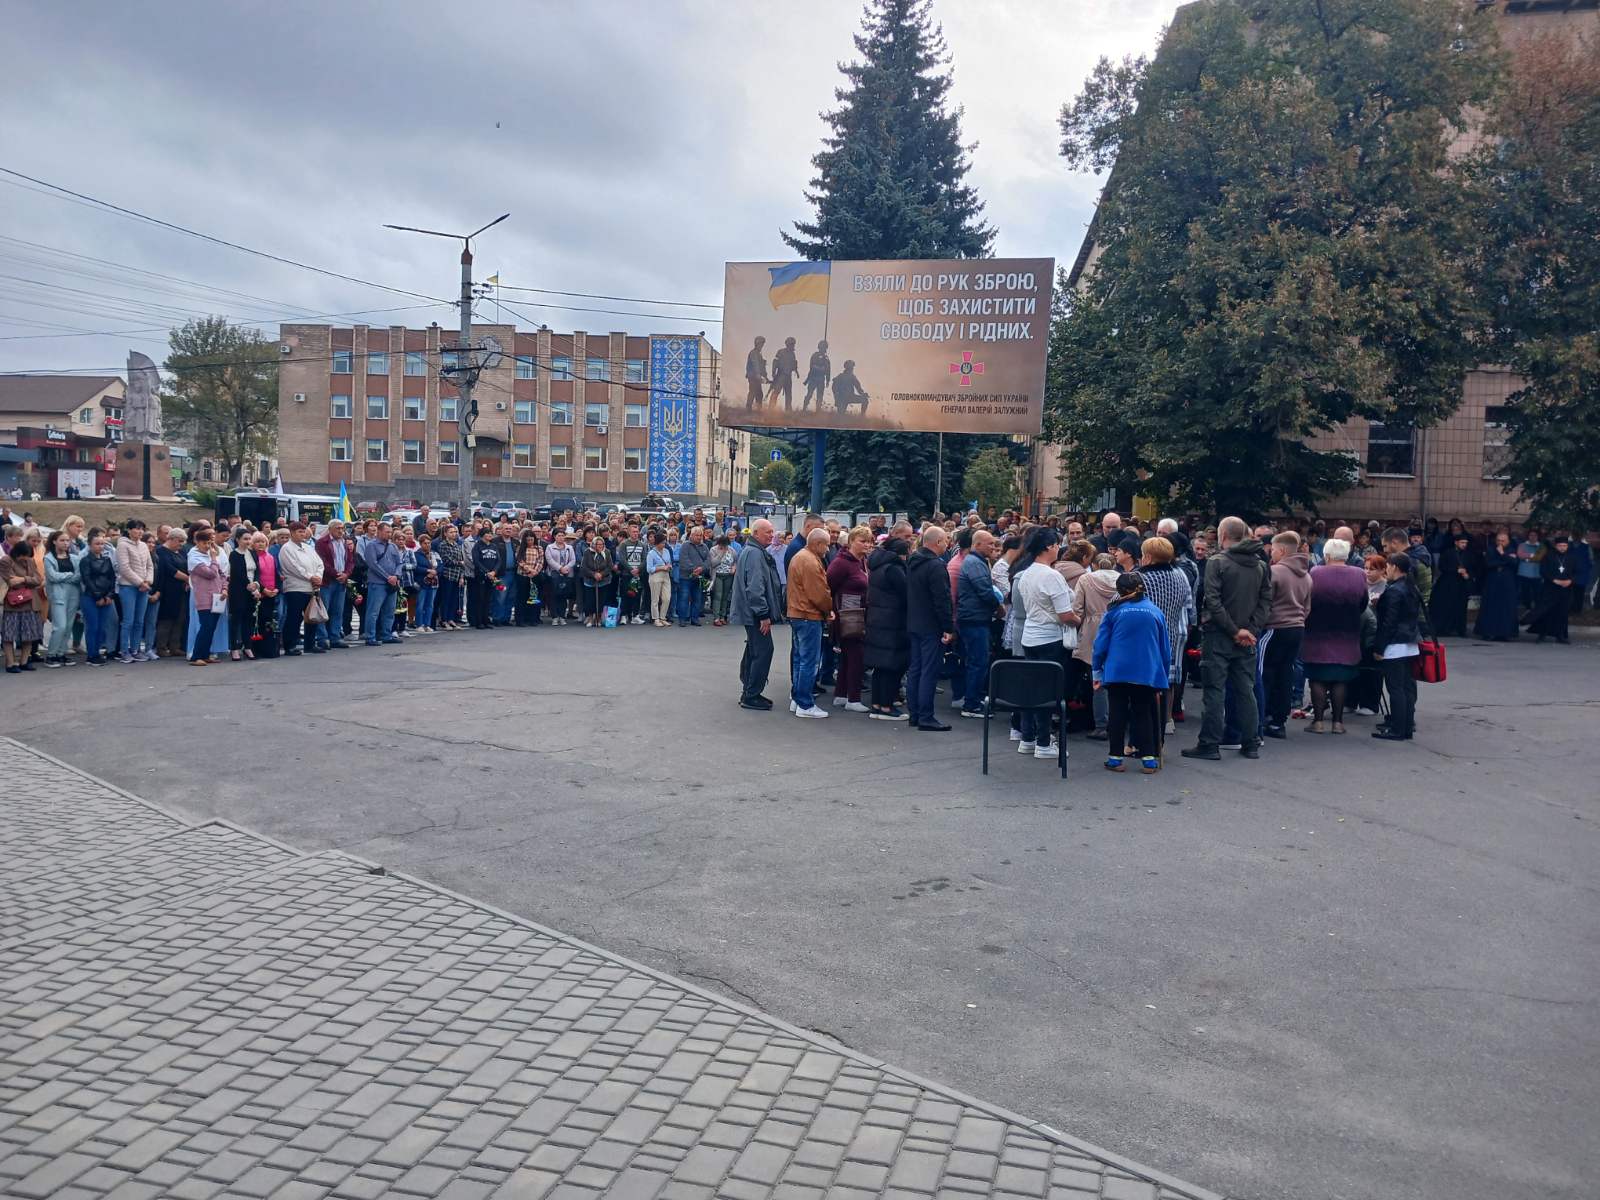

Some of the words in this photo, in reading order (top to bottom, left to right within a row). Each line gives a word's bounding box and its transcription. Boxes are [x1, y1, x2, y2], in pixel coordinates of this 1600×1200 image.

[854, 274, 906, 292] ВЗЯЛИ
[910, 274, 933, 294] ДО
[937, 273, 969, 291] РУК
[974, 273, 1038, 293] ЗБРОЮ,
[897, 298, 934, 318] ЩОБ
[938, 297, 1036, 315] ЗАХИСТИТИ
[881, 322, 955, 342] СВОБОДУ
[959, 322, 965, 340] І
[968, 322, 1034, 342] РІДНИХ.
[890, 392, 957, 402] ГОЛОВНОКОМАНДУВАЧ
[941, 405, 967, 414] ГЕНЕРАЛ
[967, 404, 993, 415] ВАЛЕРІЙ
